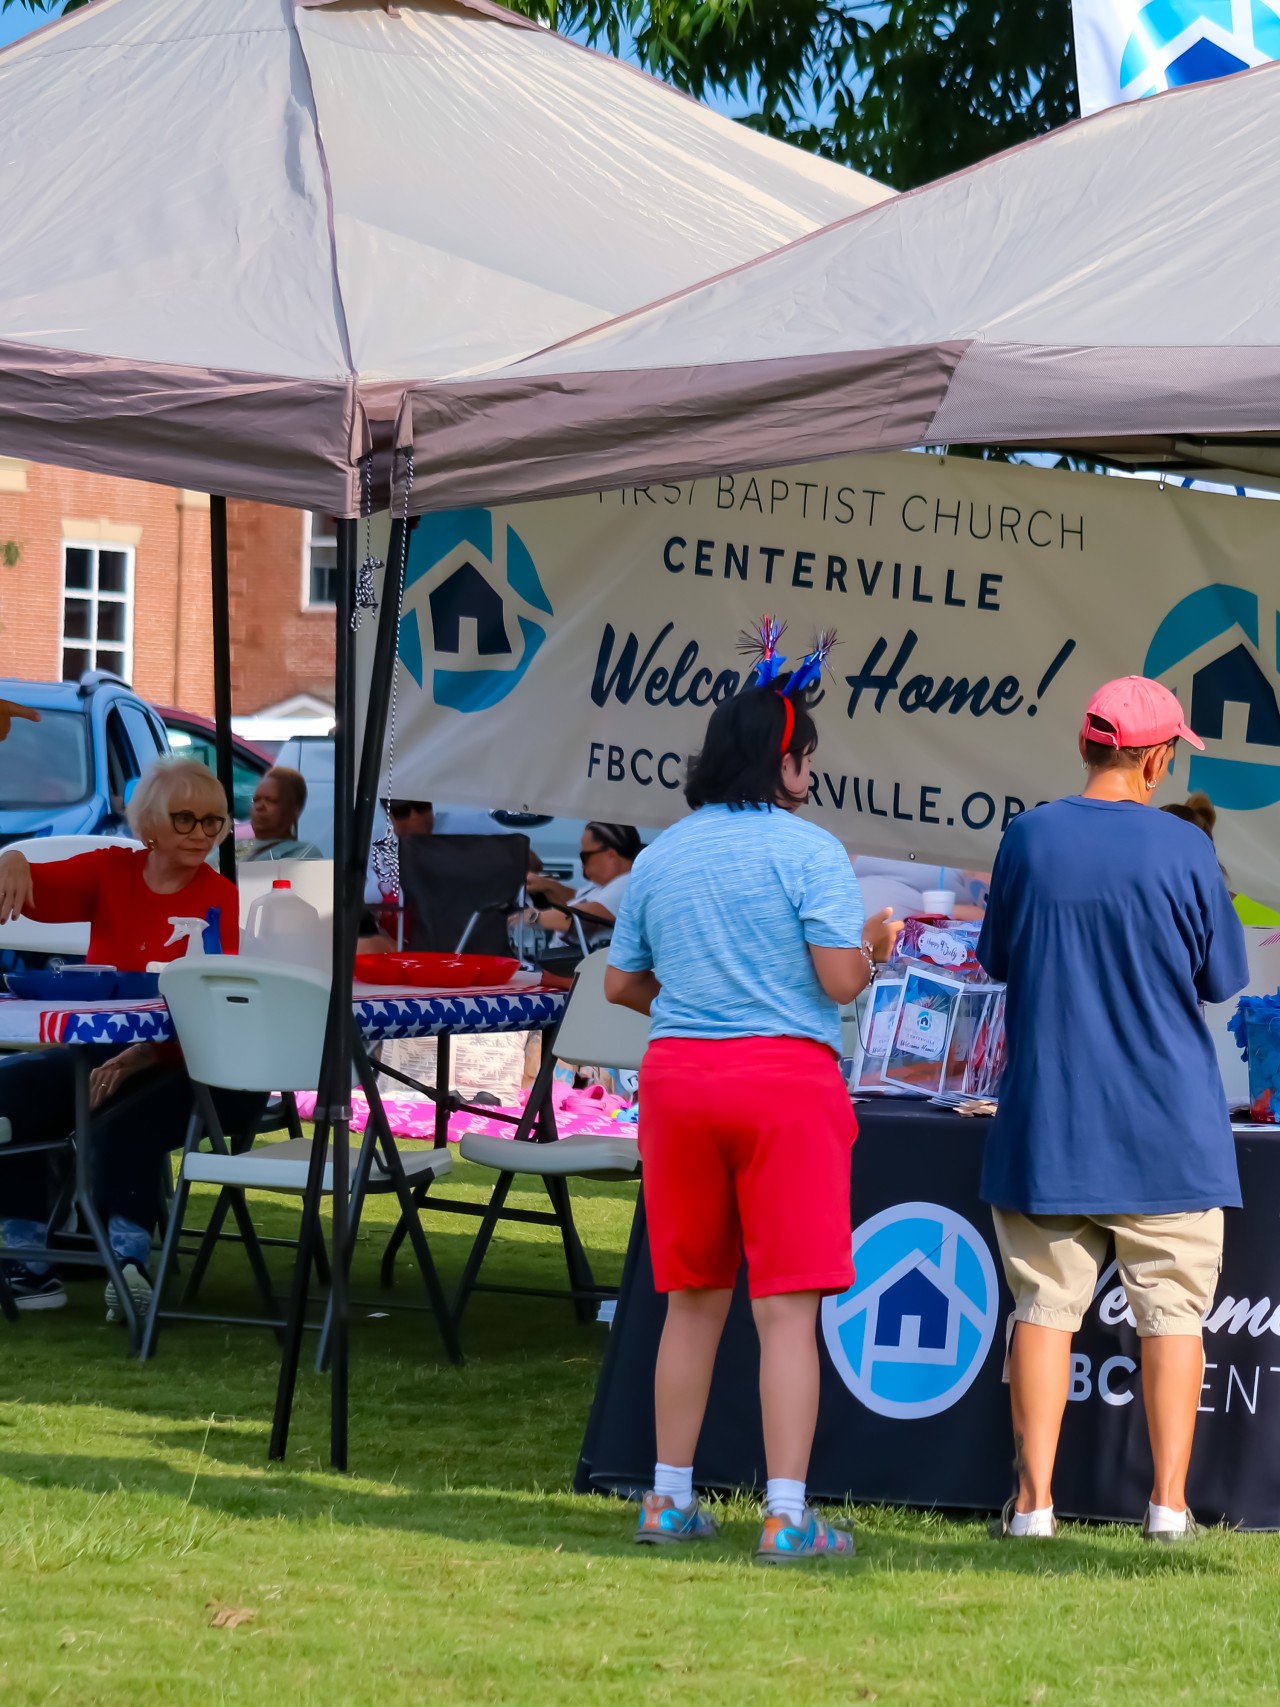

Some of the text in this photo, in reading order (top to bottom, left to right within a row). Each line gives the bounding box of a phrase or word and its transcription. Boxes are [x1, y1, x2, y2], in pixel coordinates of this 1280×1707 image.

[716, 475, 885, 526] BAPTIST
[902, 495, 1084, 551] CHURCH
[662, 536, 1003, 611] CENTERVILLE
[590, 621, 1077, 720] Welcoe Home!
